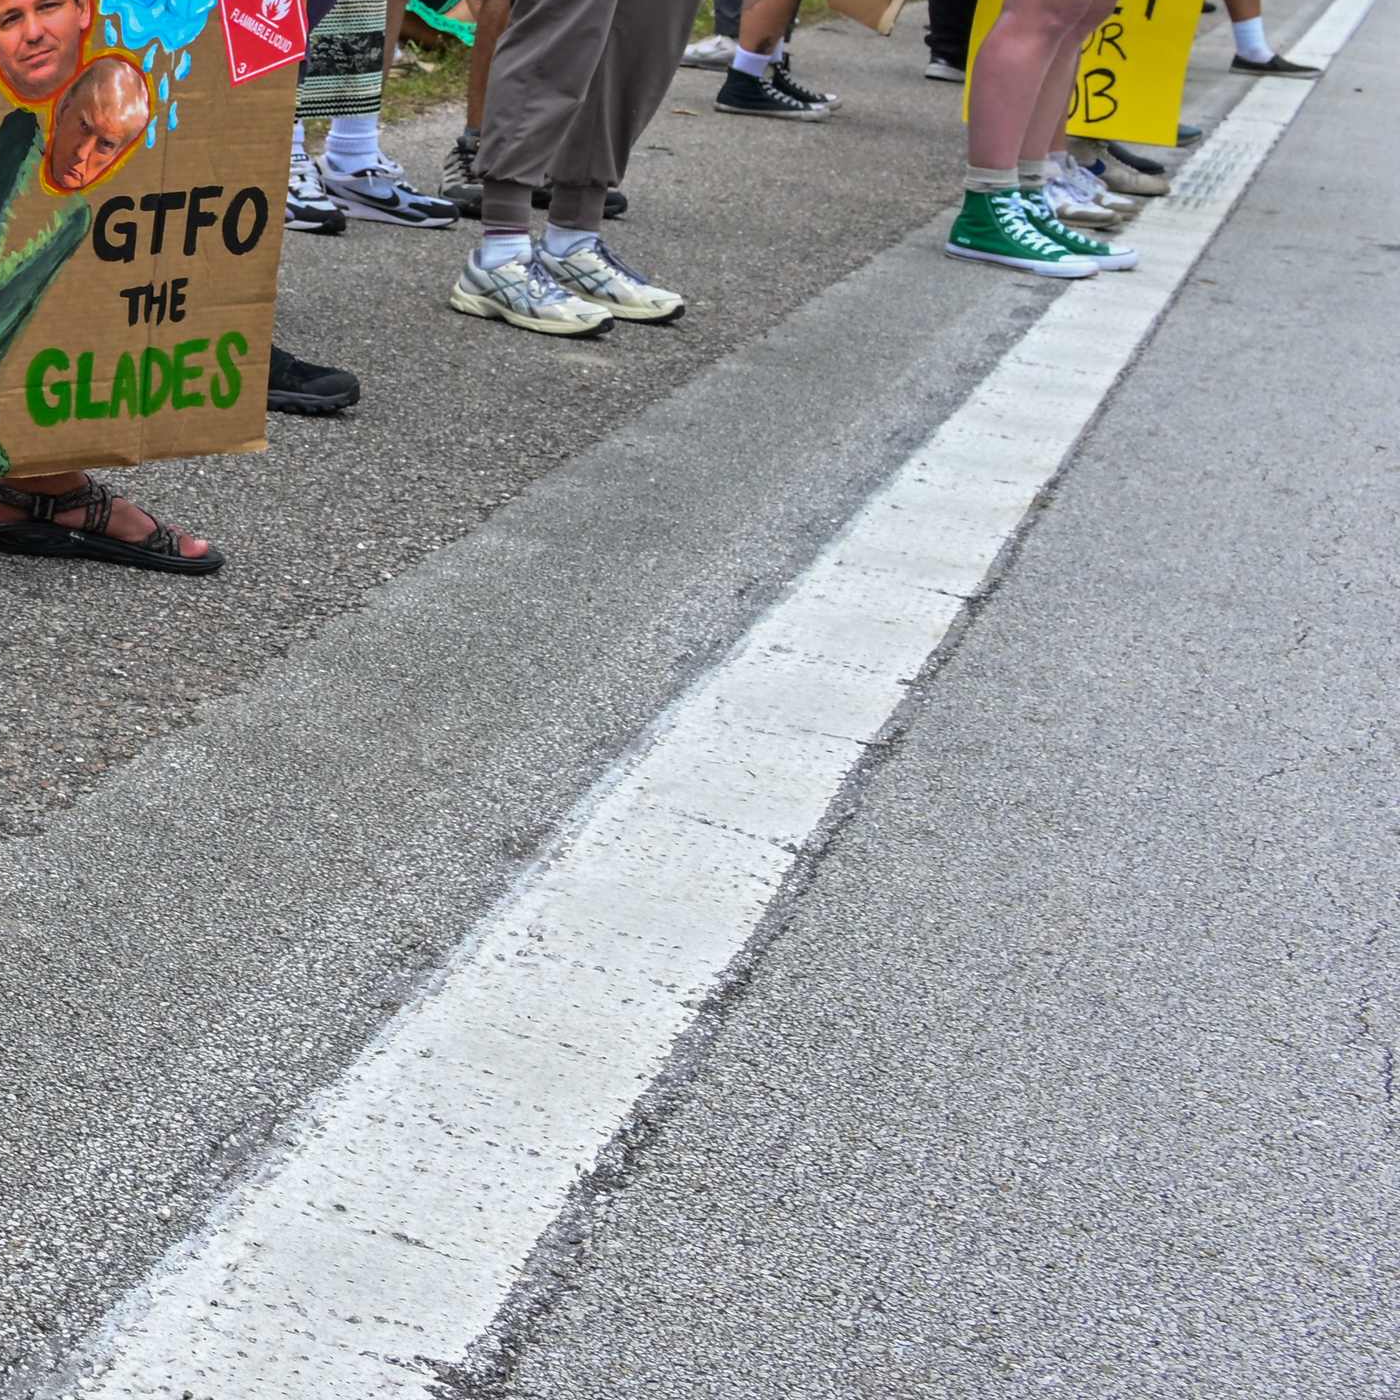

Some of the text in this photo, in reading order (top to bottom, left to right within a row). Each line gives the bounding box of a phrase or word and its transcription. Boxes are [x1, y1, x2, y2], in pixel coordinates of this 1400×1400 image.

[230, 7, 292, 55] FLAMMABLE LIQUID
[237, 62, 248, 75] 3
[92, 184, 270, 265] GTFO
[120, 277, 189, 328] THE
[24, 330, 249, 427] GLADES
